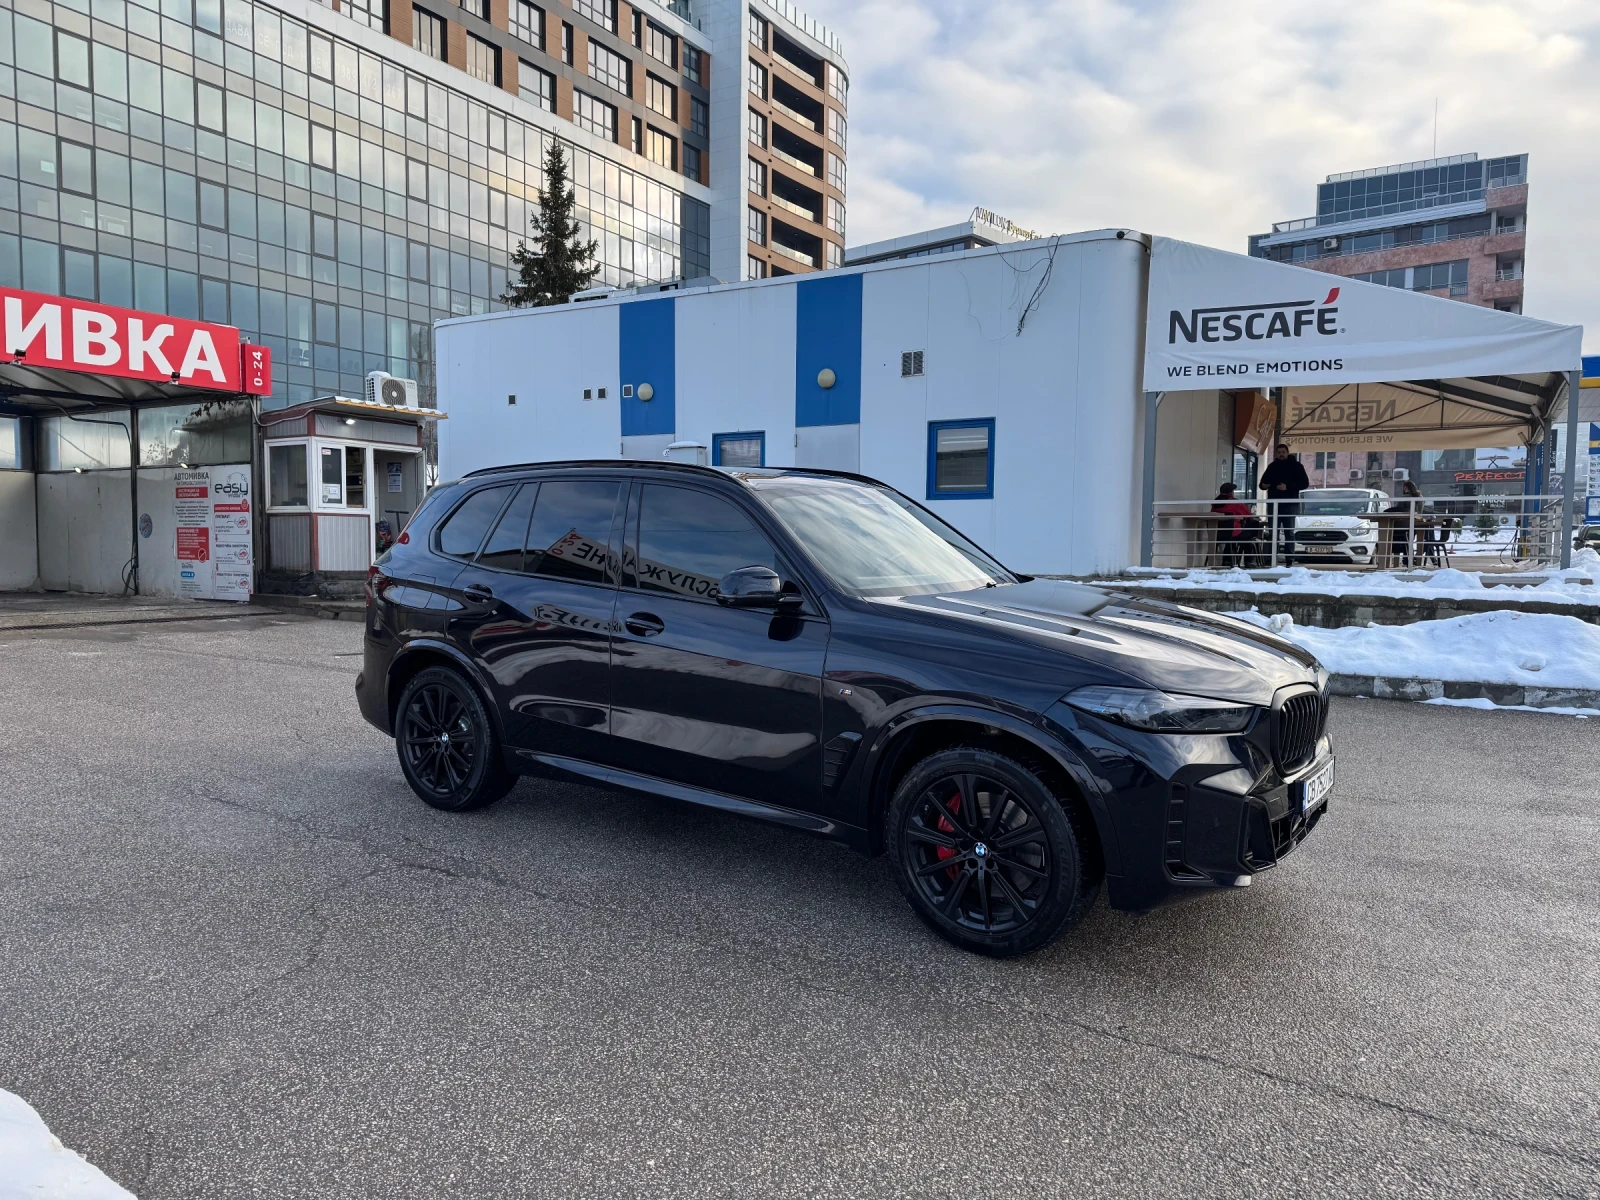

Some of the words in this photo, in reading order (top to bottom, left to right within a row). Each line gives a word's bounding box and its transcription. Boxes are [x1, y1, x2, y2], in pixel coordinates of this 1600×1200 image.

[257, 33, 270, 48] СЕ
[1169, 287, 1341, 344] NESCAFÉ
[4, 296, 227, 383] ИВКА
[252, 351, 262, 386] 0-24
[1167, 365, 1192, 377] WE
[1196, 363, 1249, 376] BLEND
[1256, 358, 1343, 374] EMOTIONS
[174, 471, 210, 481] АВТОМИВКА
[1454, 471, 1526, 482] PERFECT
[214, 483, 249, 496] easy
